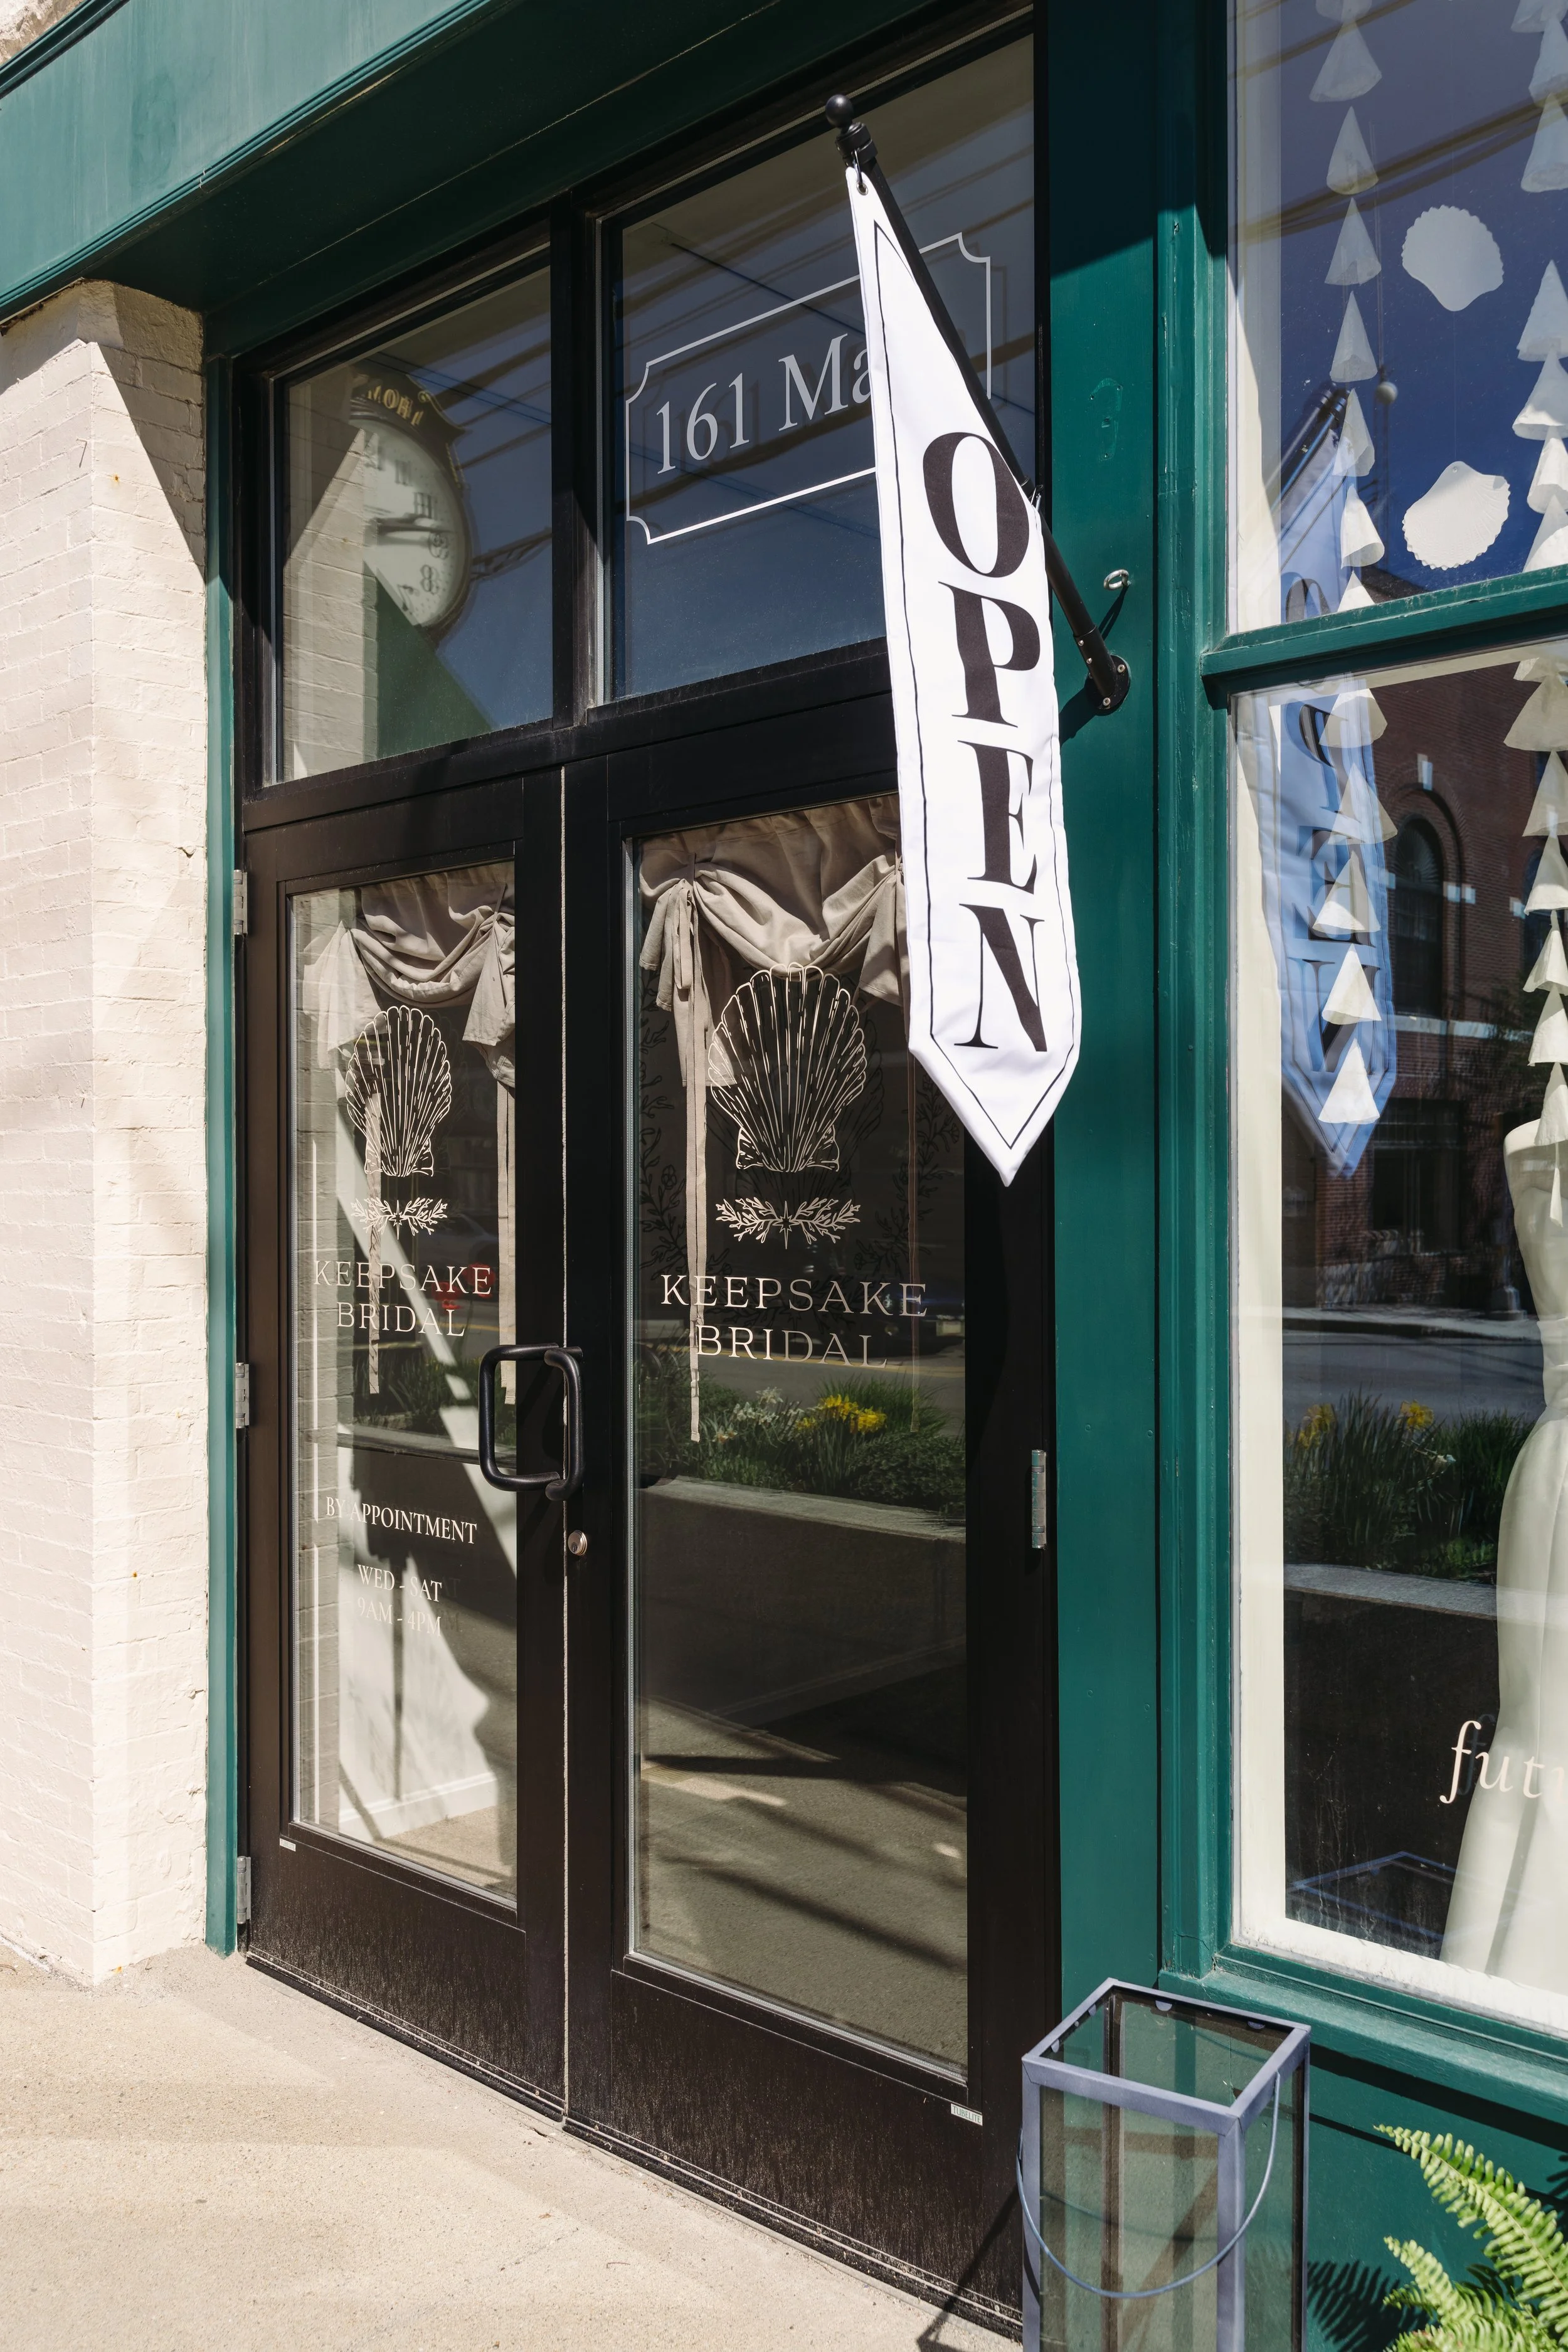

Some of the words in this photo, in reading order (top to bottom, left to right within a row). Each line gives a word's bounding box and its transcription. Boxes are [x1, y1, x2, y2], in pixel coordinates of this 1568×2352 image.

[656, 373, 750, 474] 161
[778, 333, 872, 432] Ma
[923, 432, 1046, 1052] OPEN
[314, 1260, 492, 1295] KEEPSAKE
[660, 1274, 928, 1317] KEEPSAKE
[336, 1302, 465, 1337] BRIDAL
[695, 1325, 887, 1369] BRIDAL
[326, 1496, 346, 1518] BY
[349, 1503, 477, 1544] APPOINTMENT
[358, 1564, 395, 1591] WED
[410, 1576, 442, 1602] SAT
[358, 1597, 393, 1624] 9AM
[407, 1611, 442, 1637] 4PM
[952, 2105, 981, 2124] TUBELITE
